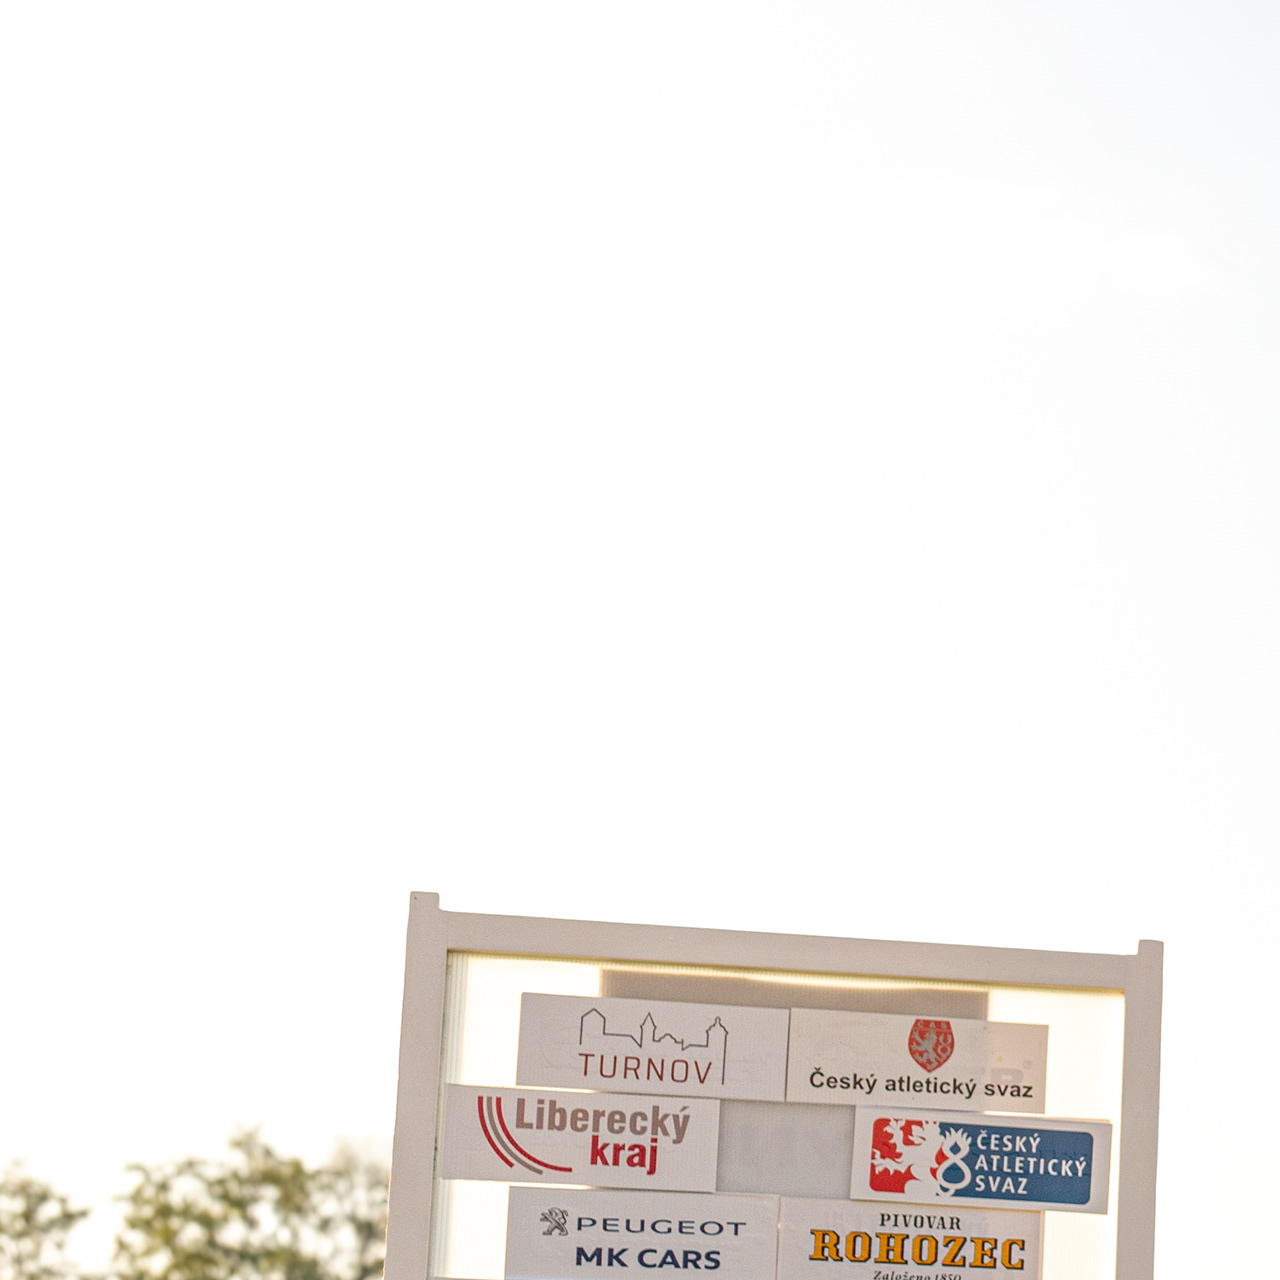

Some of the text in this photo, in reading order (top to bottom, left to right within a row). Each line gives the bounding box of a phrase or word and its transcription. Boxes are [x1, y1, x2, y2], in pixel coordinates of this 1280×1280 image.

[578, 1053, 712, 1084] TURNOV
[810, 1067, 1033, 1099] Český atletický svaz
[515, 1098, 691, 1144] Liberecký
[977, 1129, 1041, 1152] ČESKÝ
[590, 1135, 658, 1175] kraj
[975, 1153, 1087, 1177] ATLETICKÝ
[975, 1174, 1028, 1195] SVAZ
[576, 1217, 747, 1237] PEUGEOT
[879, 1213, 962, 1231] PIVOVAR
[576, 1247, 722, 1271] MK CARS
[808, 1229, 1026, 1271] ROHOZEC
